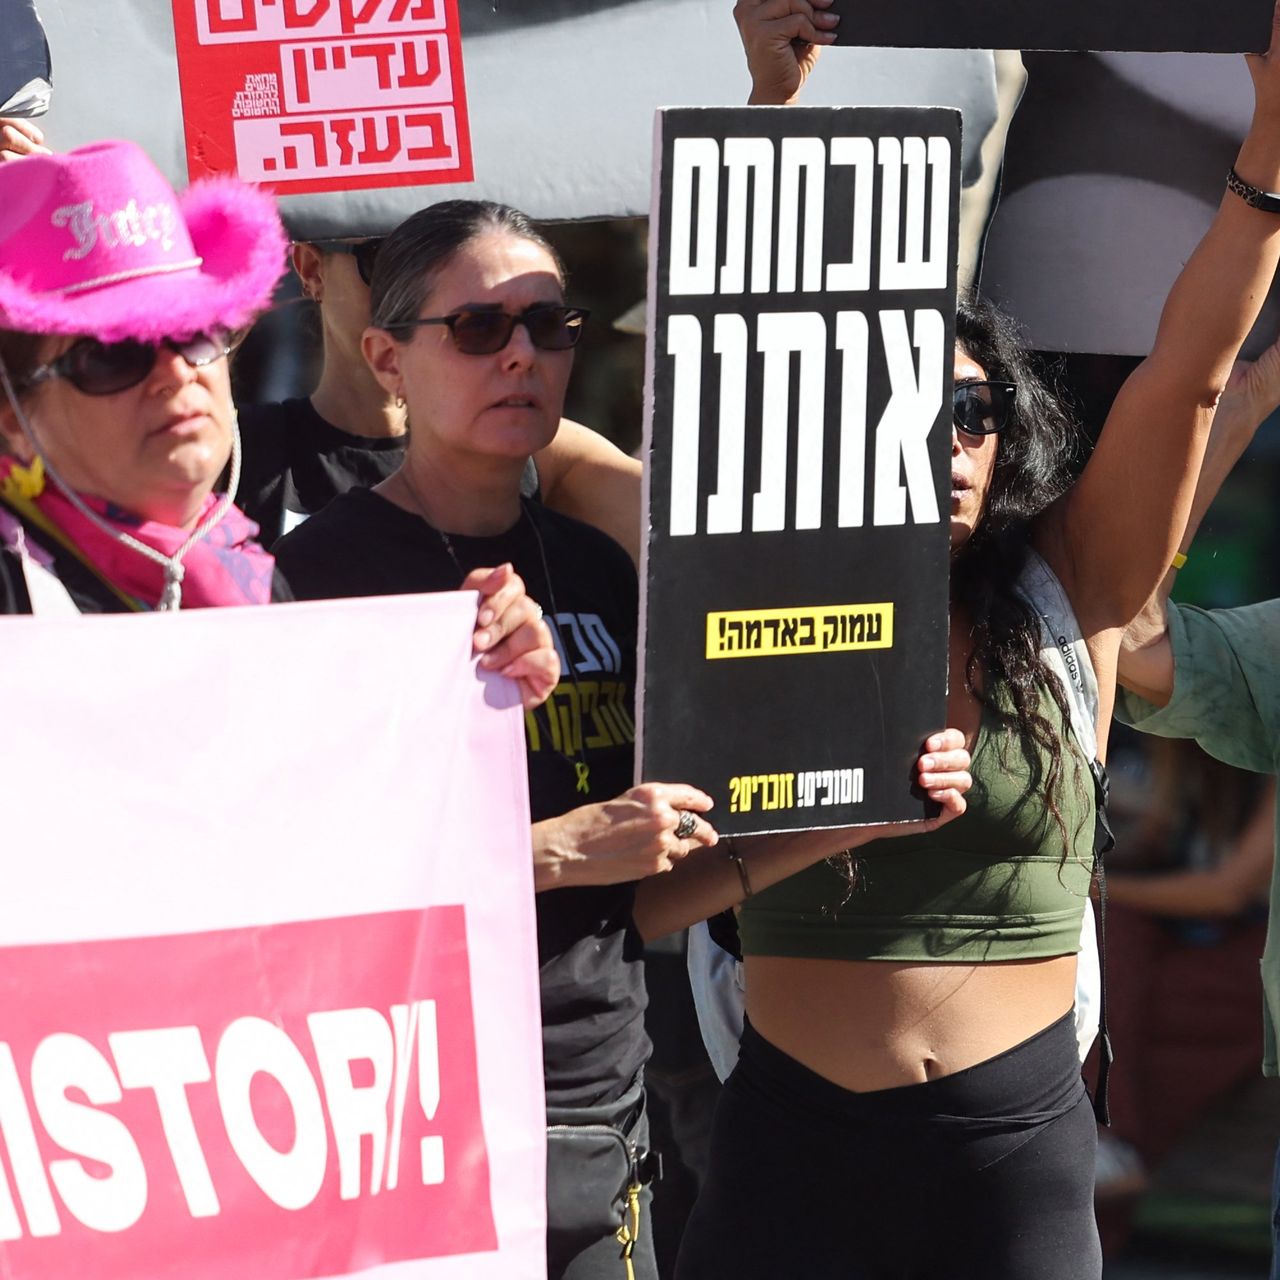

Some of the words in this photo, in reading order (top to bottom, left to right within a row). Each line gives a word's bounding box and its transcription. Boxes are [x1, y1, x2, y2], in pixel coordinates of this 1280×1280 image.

[292, 39, 442, 105] עדיין
[263, 112, 453, 172] בעזה.
[668, 136, 951, 296] שכחתם
[667, 308, 946, 537] אותנו
[718, 616, 816, 651] באדמה!
[823, 612, 882, 650] עמוק
[1057, 635, 1078, 681] adidas
[729, 772, 795, 813] זוכרים?
